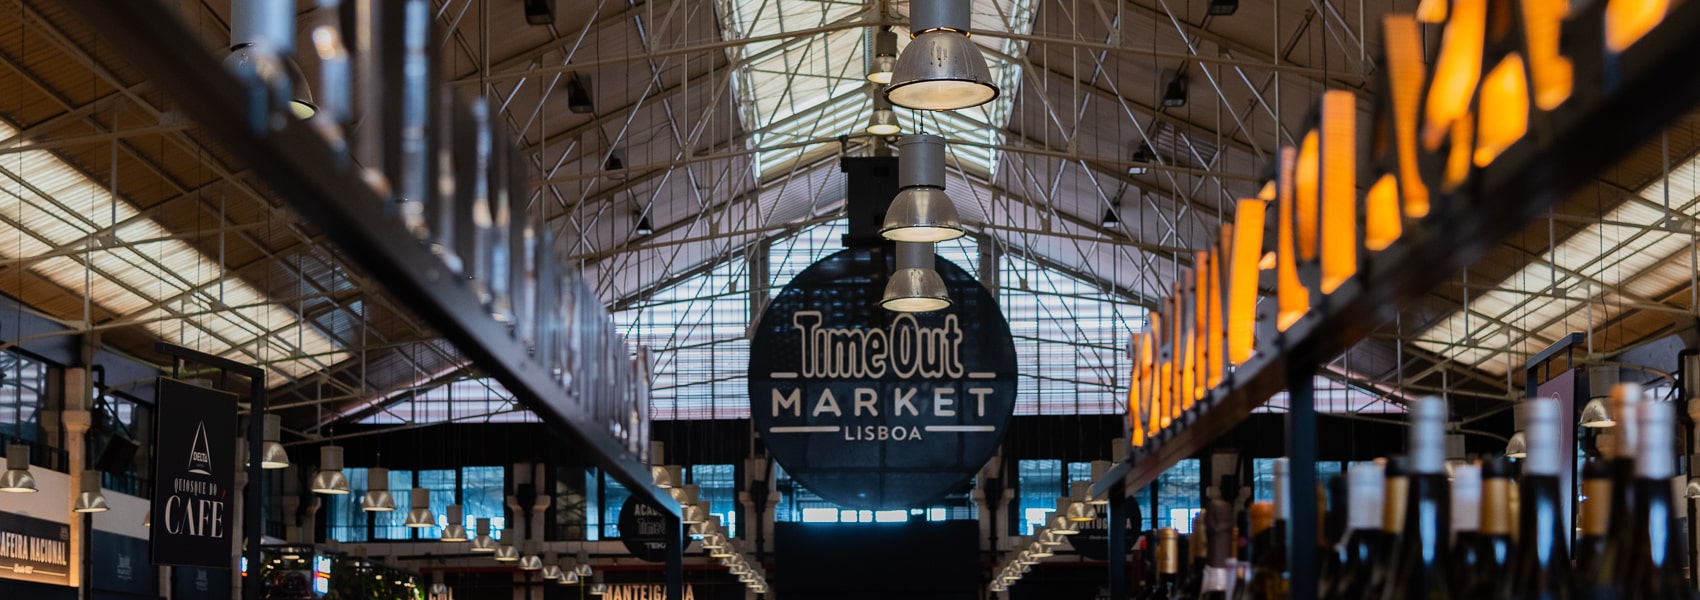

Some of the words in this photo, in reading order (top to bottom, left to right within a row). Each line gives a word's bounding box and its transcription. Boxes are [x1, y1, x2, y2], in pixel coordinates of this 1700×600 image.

[793, 311, 888, 379] Time
[890, 313, 964, 379] Out
[772, 387, 994, 417] MARKET
[845, 425, 922, 441] LISBOA
[193, 451, 208, 463] DELTA
[174, 478, 206, 496] QUIOSQUE
[209, 483, 218, 496] DO
[165, 489, 227, 538] CAFÉ
[30, 537, 66, 565] NACIONAL
